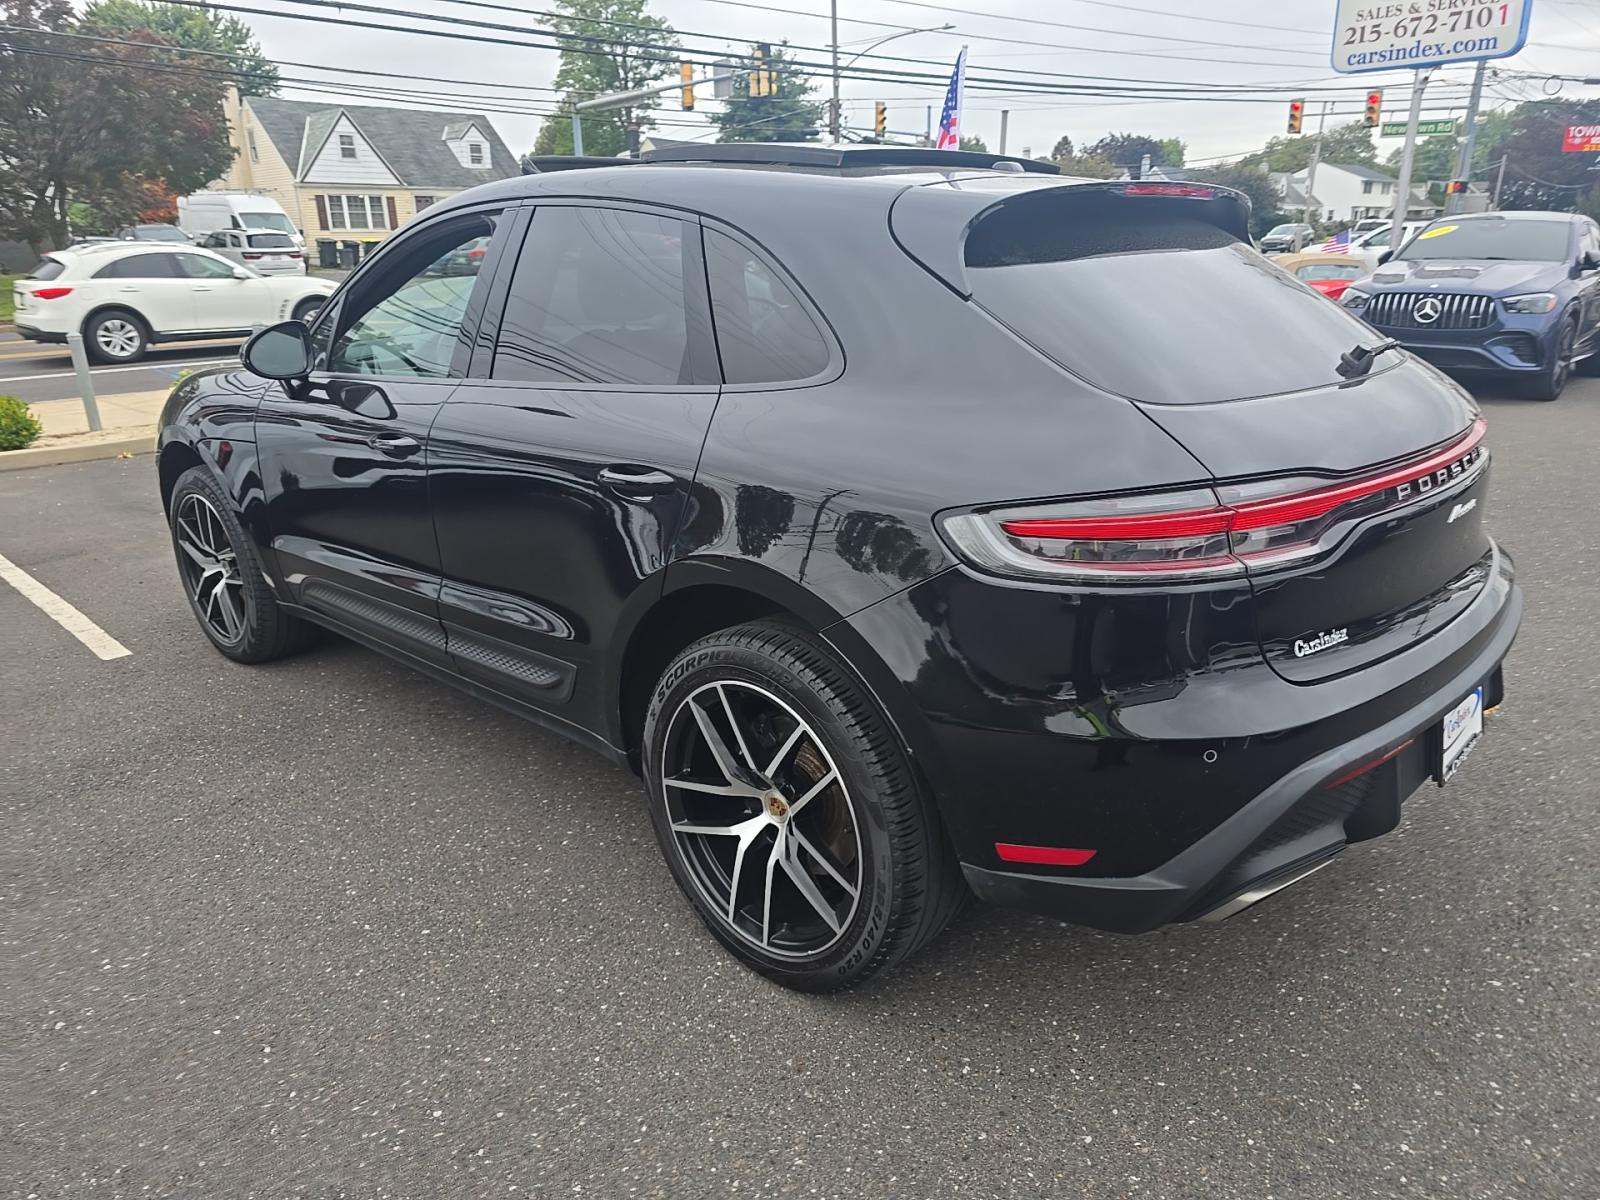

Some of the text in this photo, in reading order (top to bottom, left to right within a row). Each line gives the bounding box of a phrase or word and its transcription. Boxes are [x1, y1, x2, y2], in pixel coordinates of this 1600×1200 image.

[1355, 0, 1501, 22] SALES & SERV
[1343, 4, 1508, 46] 215-672-7101
[1347, 37, 1498, 66] carsindex.com
[1384, 121, 1453, 135] Newwn Rd
[838, 949, 863, 975] R20
